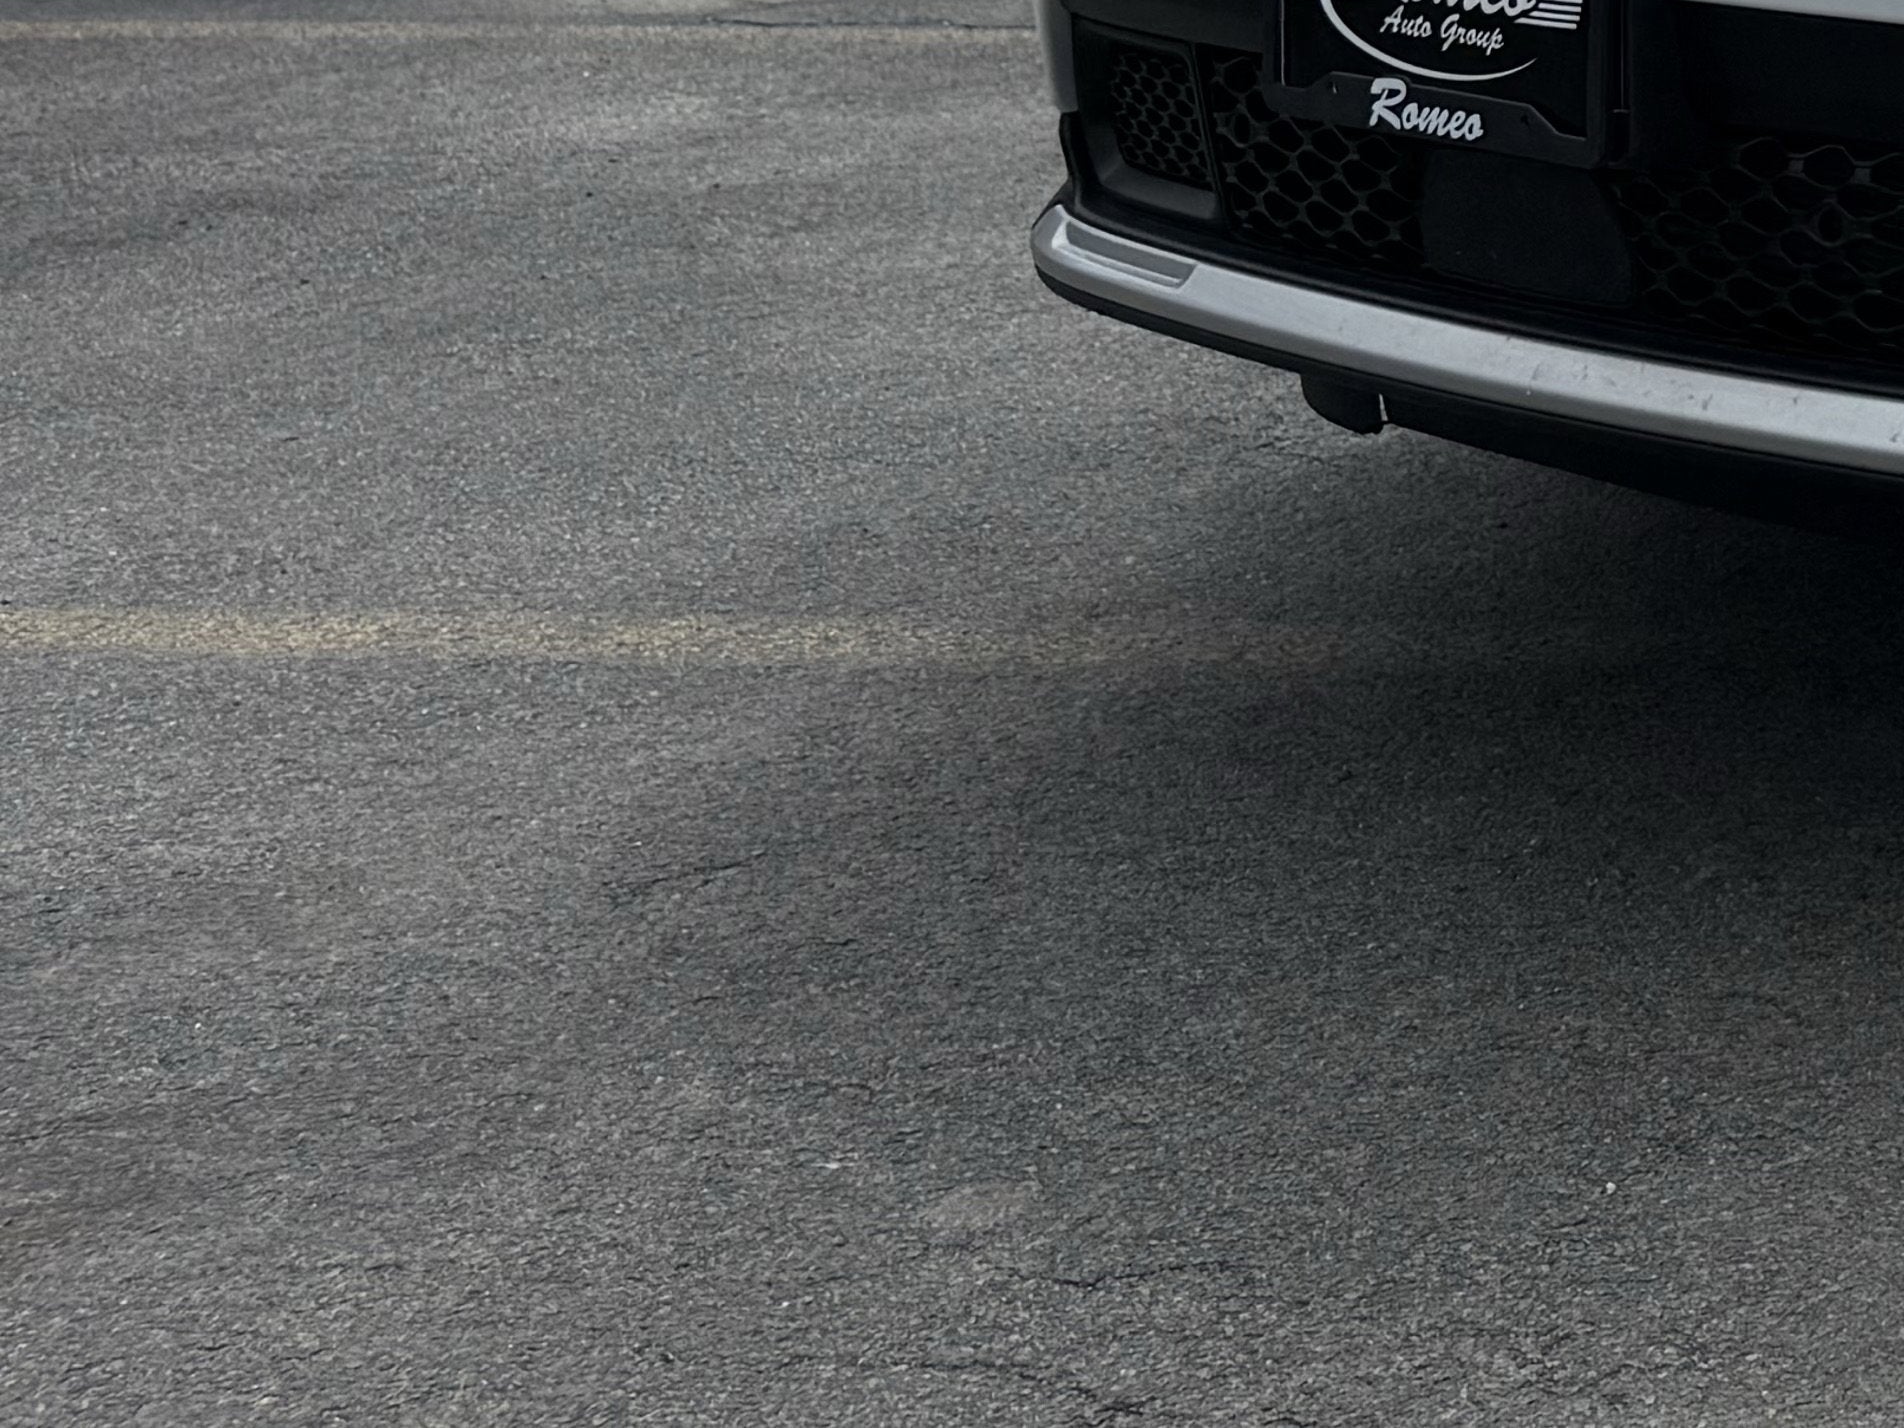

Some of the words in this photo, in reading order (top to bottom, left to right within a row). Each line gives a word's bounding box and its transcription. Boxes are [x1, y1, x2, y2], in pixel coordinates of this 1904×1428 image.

[1380, 4, 1432, 38] Auto
[1440, 14, 1504, 55] Group
[1369, 78, 1484, 141] Romeo
